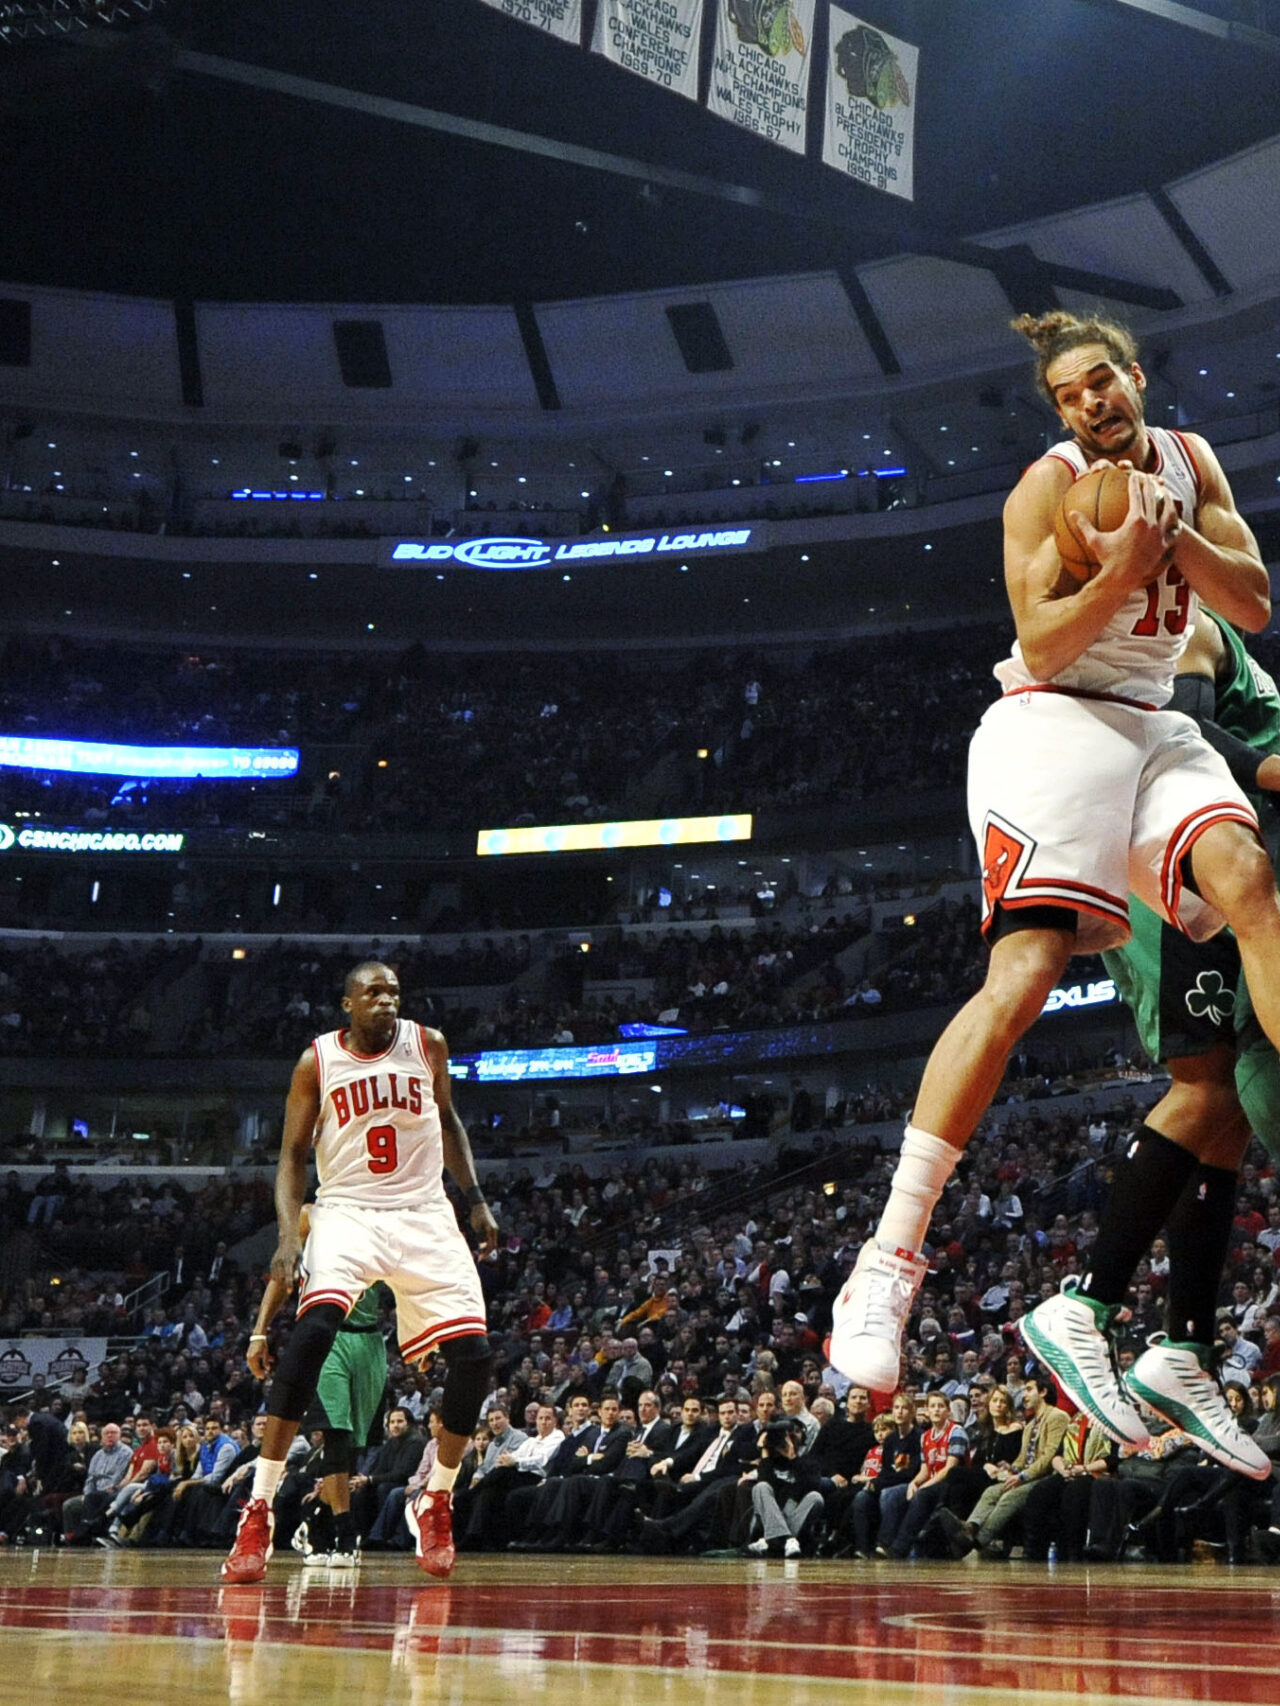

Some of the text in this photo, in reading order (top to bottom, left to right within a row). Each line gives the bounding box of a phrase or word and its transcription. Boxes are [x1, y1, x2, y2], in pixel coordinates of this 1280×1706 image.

[620, 0, 691, 38] ACKHAWKS
[631, 13, 670, 43] WALES
[608, 16, 688, 67] CONFERENCE
[612, 33, 681, 76] CHAMPIONS
[738, 43, 786, 76] CHICAGO
[620, 51, 672, 86] 1969-70
[726, 49, 799, 95] BLACKHAWKS
[717, 86, 801, 136] WALES TROPHY
[733, 81, 787, 116] PRINCE OF
[848, 96, 893, 128] CHICAGO
[733, 109, 781, 140] 1966-67
[835, 102, 904, 145] BLACKHAWKS
[838, 143, 897, 180] CHAMPIONS
[848, 135, 889, 163] TROPHY
[393, 529, 751, 560] BUD LIGHT LEGENDS LOUNGE
[1130, 563, 1190, 636] 13
[1041, 979, 1115, 1012] EXUS
[331, 1073, 422, 1128] BULLS
[366, 1125, 398, 1174] 9
